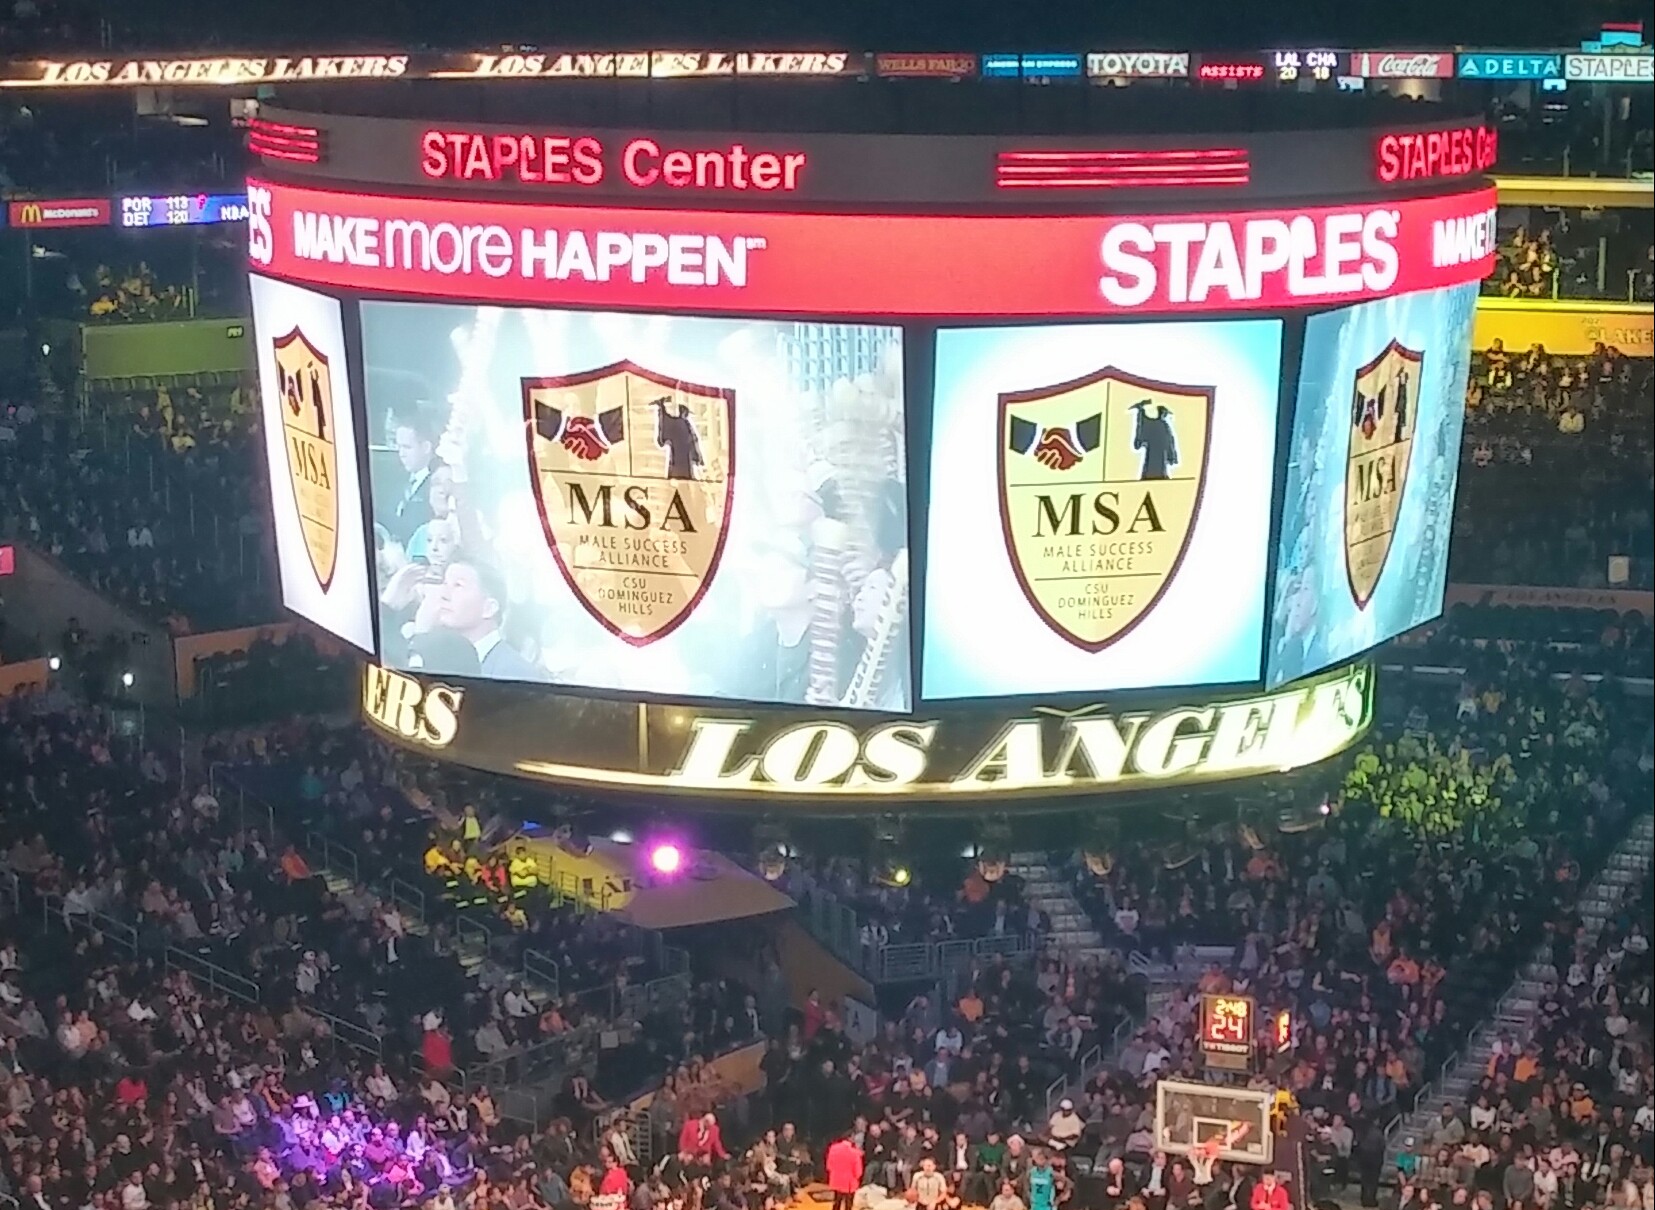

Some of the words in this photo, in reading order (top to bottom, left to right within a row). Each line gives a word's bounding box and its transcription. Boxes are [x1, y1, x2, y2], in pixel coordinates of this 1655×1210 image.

[44, 61, 111, 81] LOS
[115, 57, 269, 82] ANGELES
[271, 55, 409, 78] LAKERS
[475, 53, 546, 75] LOS
[880, 58, 925, 71] WELLS
[1090, 54, 1187, 75] TOYOTA
[1276, 52, 1301, 66] LAL
[1306, 52, 1337, 66] CHA
[1485, 55, 1558, 75] DELTA
[1569, 57, 1654, 78] STAPLE
[1201, 65, 1263, 77] ASSISTS
[1280, 66, 1297, 80] 20
[421, 131, 603, 185] STAPLES
[623, 138, 806, 191] Center
[1380, 127, 1473, 182] STAPLES
[122, 197, 152, 212] POR
[122, 211, 151, 226] DET
[166, 210, 189, 225] 120
[293, 209, 380, 269] MAKE
[383, 218, 513, 279] more
[520, 227, 748, 287] HAPPEN
[1432, 213, 1485, 268] MAKE
[1100, 208, 1400, 307] STAPLES
[292, 436, 331, 490] MSA
[1353, 455, 1397, 505] MSA
[564, 481, 698, 533] MSA
[1031, 490, 1167, 537] MSA
[580, 534, 616, 549] MALE
[624, 538, 687, 554] SUCCESS
[1043, 544, 1082, 558] MALE
[1089, 541, 1153, 557] SUCCESS
[600, 550, 669, 568] ALLIANCE
[1062, 557, 1133, 573] ALLIANCE
[623, 576, 646, 589] CSU
[1085, 583, 1109, 595] CSU
[598, 588, 673, 604] DOMINGUEZ
[1058, 594, 1134, 608] DOMINGUEZ
[618, 602, 653, 616] HILLS
[1078, 608, 1113, 619] HILLS
[667, 716, 941, 790] LOS
[950, 664, 1370, 791] ANGELES
[1211, 1012, 1243, 1040] 24
